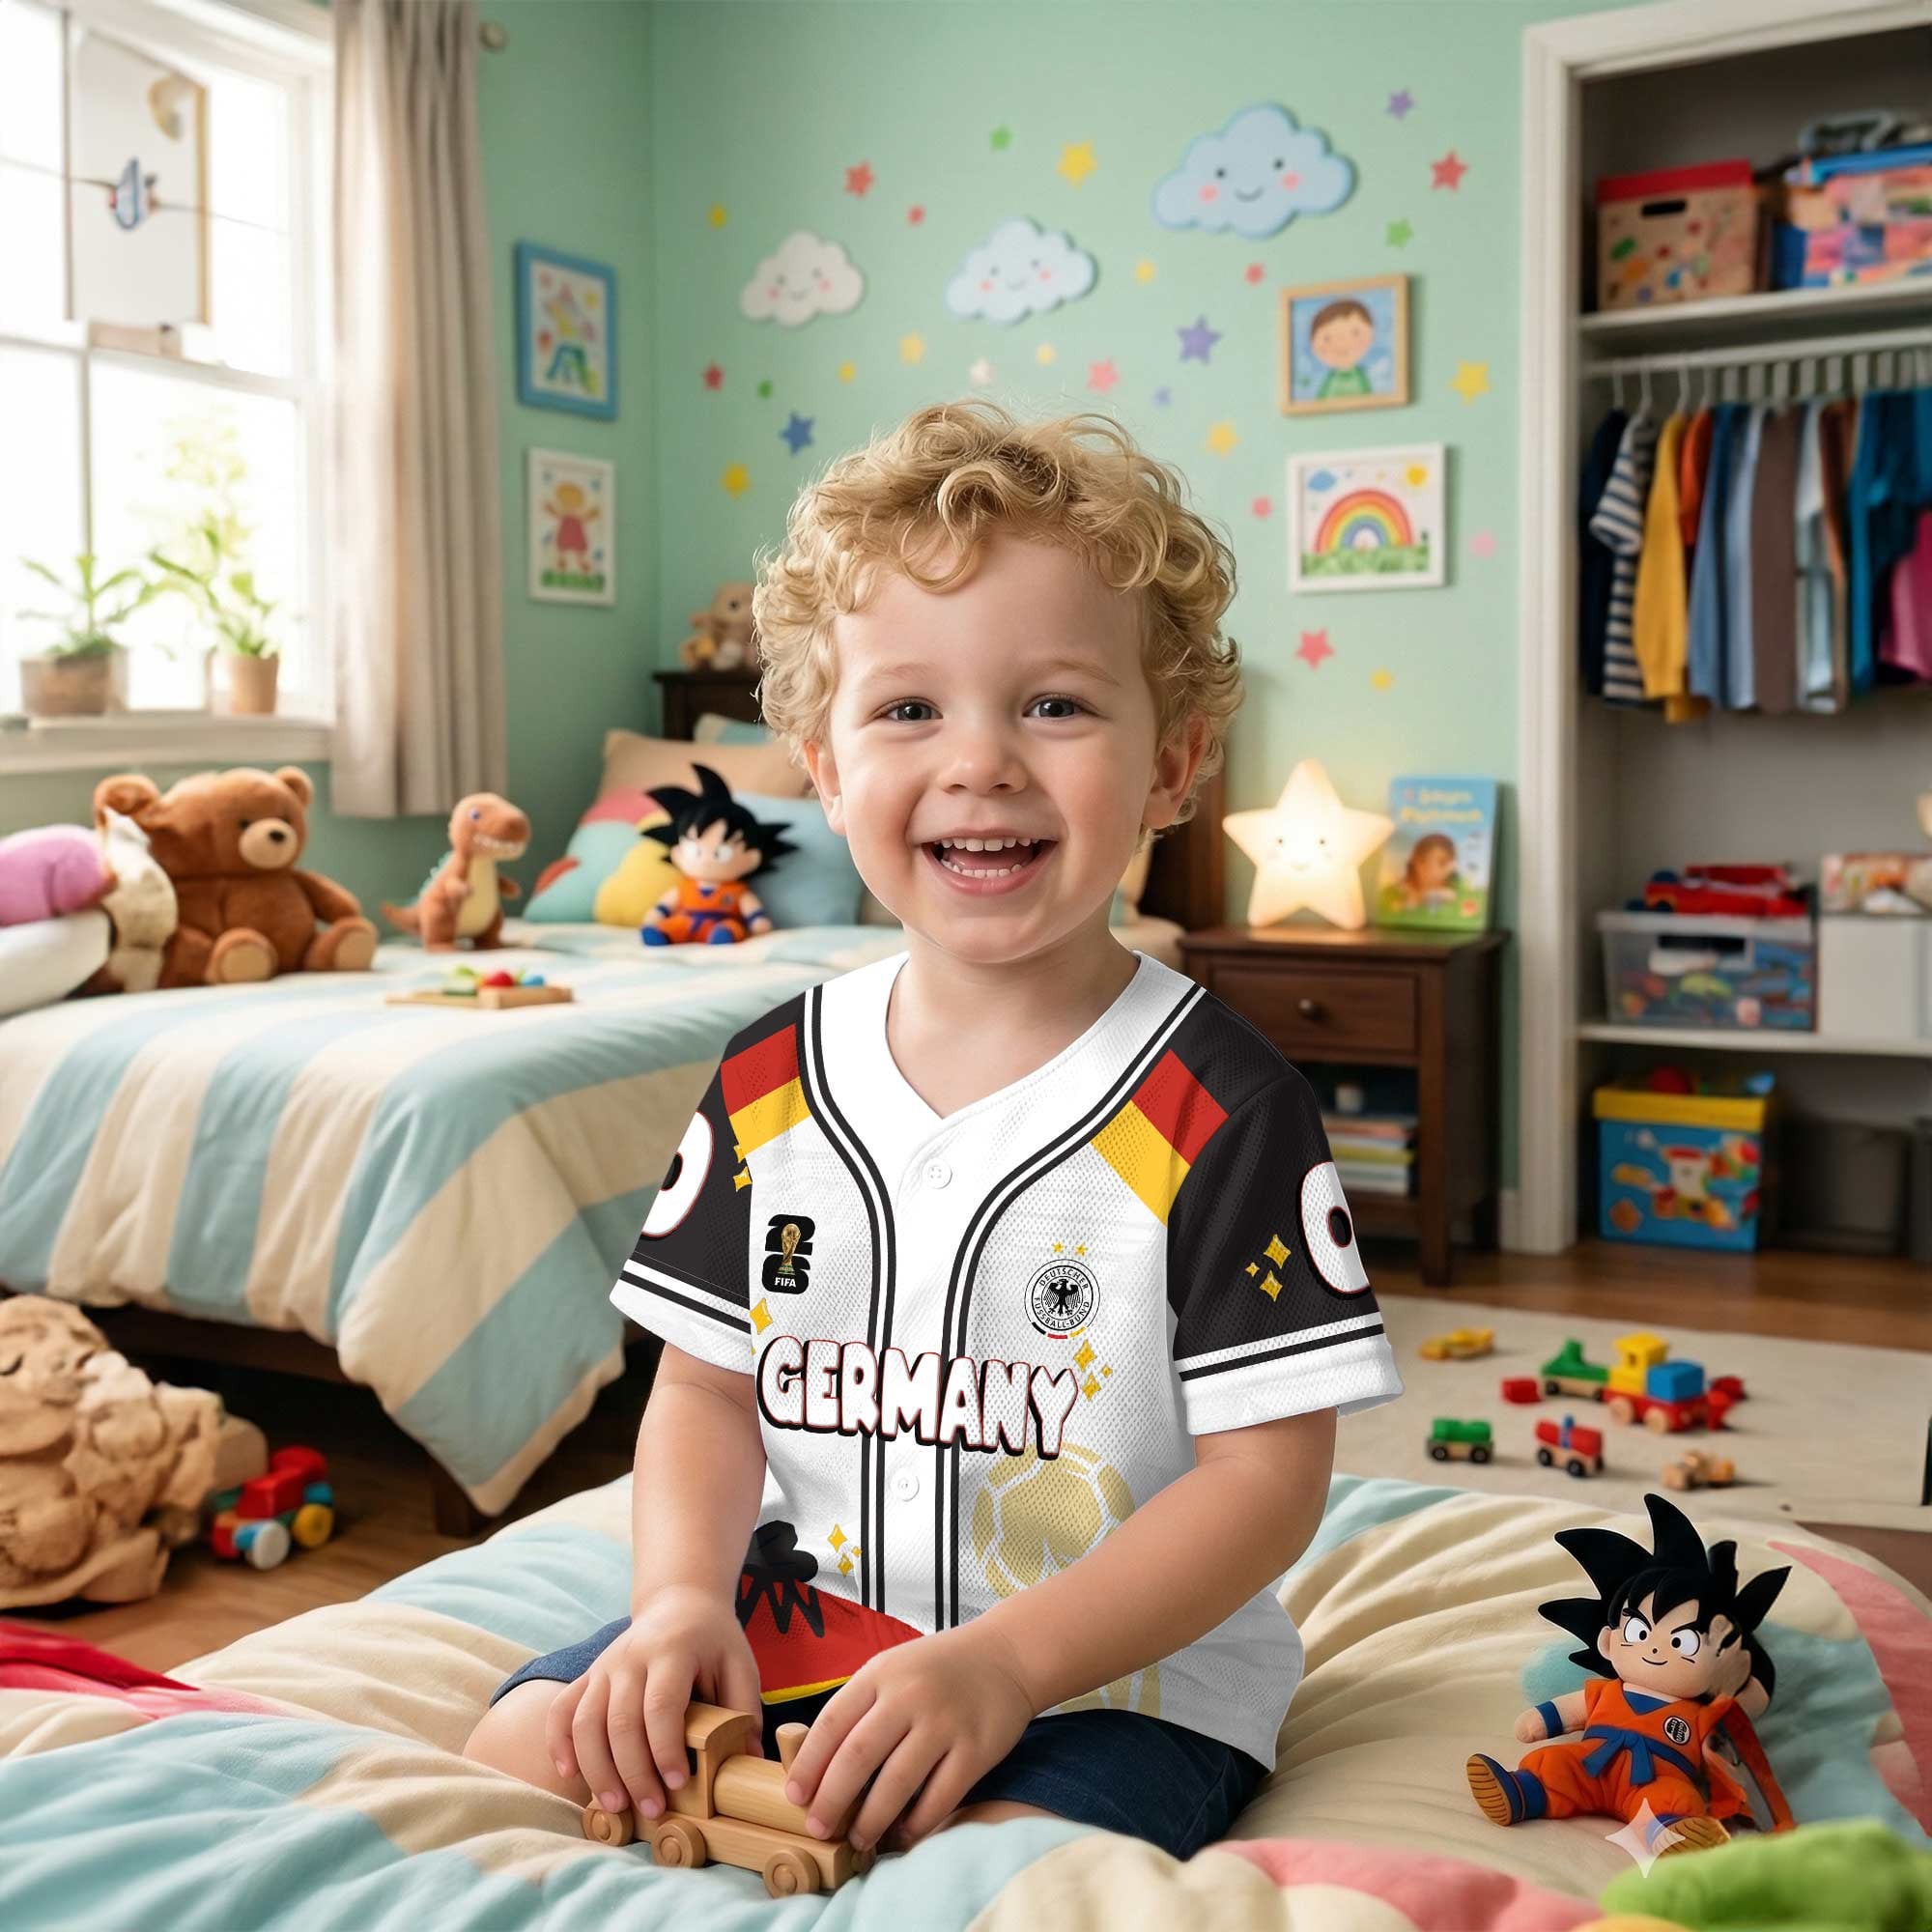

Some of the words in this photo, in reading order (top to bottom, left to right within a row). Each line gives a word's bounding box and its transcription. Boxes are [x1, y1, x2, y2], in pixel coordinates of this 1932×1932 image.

[774, 1276, 797, 1288] FIFA
[1038, 1267, 1089, 1290] DEUTSCHER
[1034, 1296, 1090, 1328] FUSSBALL-BUND
[756, 1335, 1079, 1461] GERMANY
